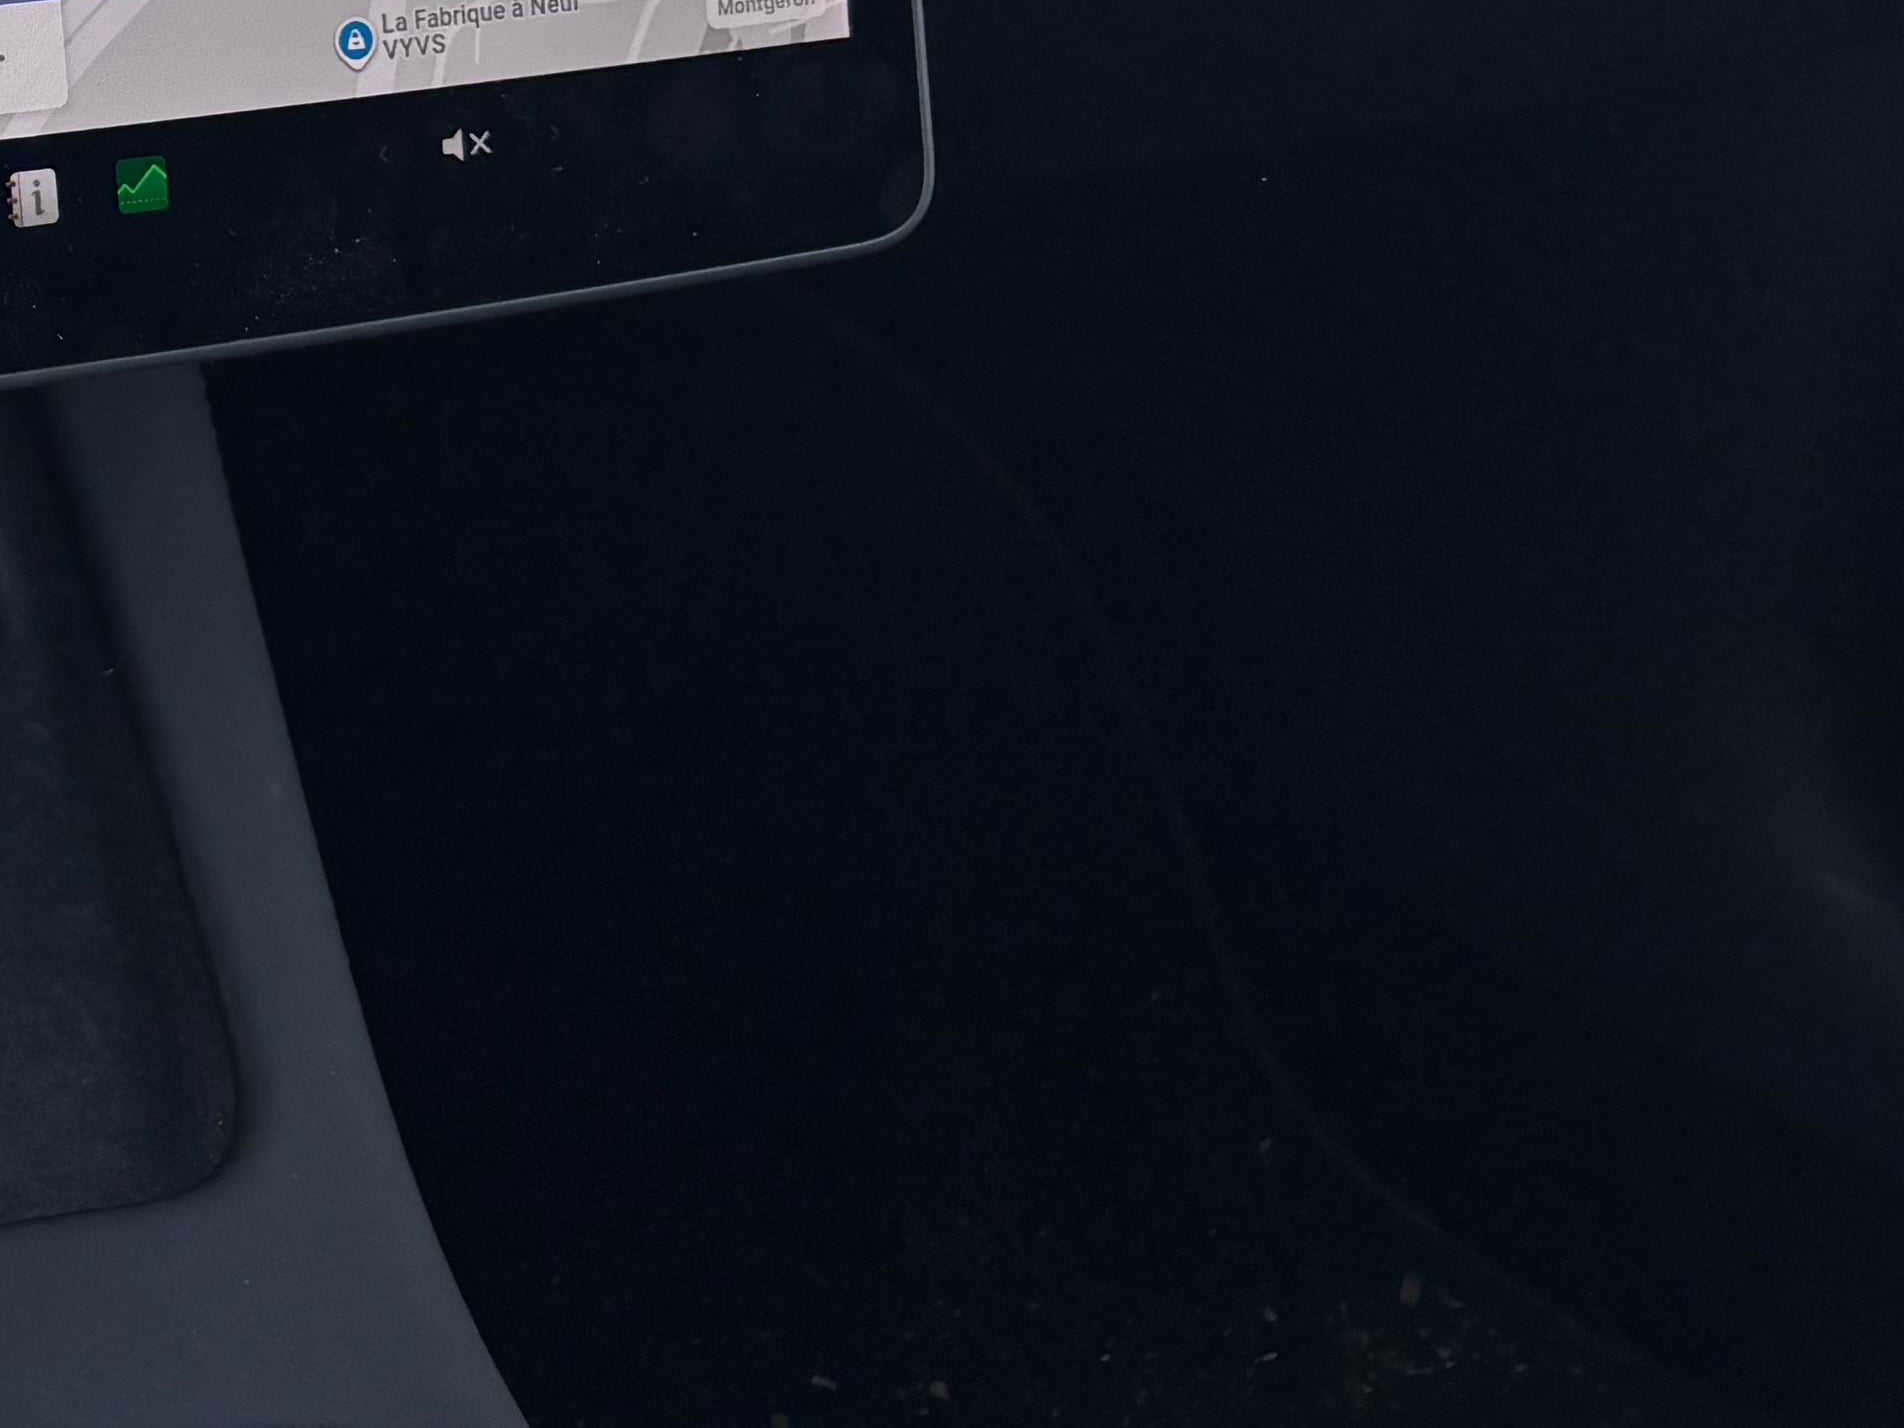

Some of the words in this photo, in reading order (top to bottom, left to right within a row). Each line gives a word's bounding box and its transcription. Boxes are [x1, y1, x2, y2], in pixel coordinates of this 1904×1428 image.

[382, 13, 408, 34] La
[414, 2, 505, 32] Fabrique
[384, 34, 446, 58] VYVS
